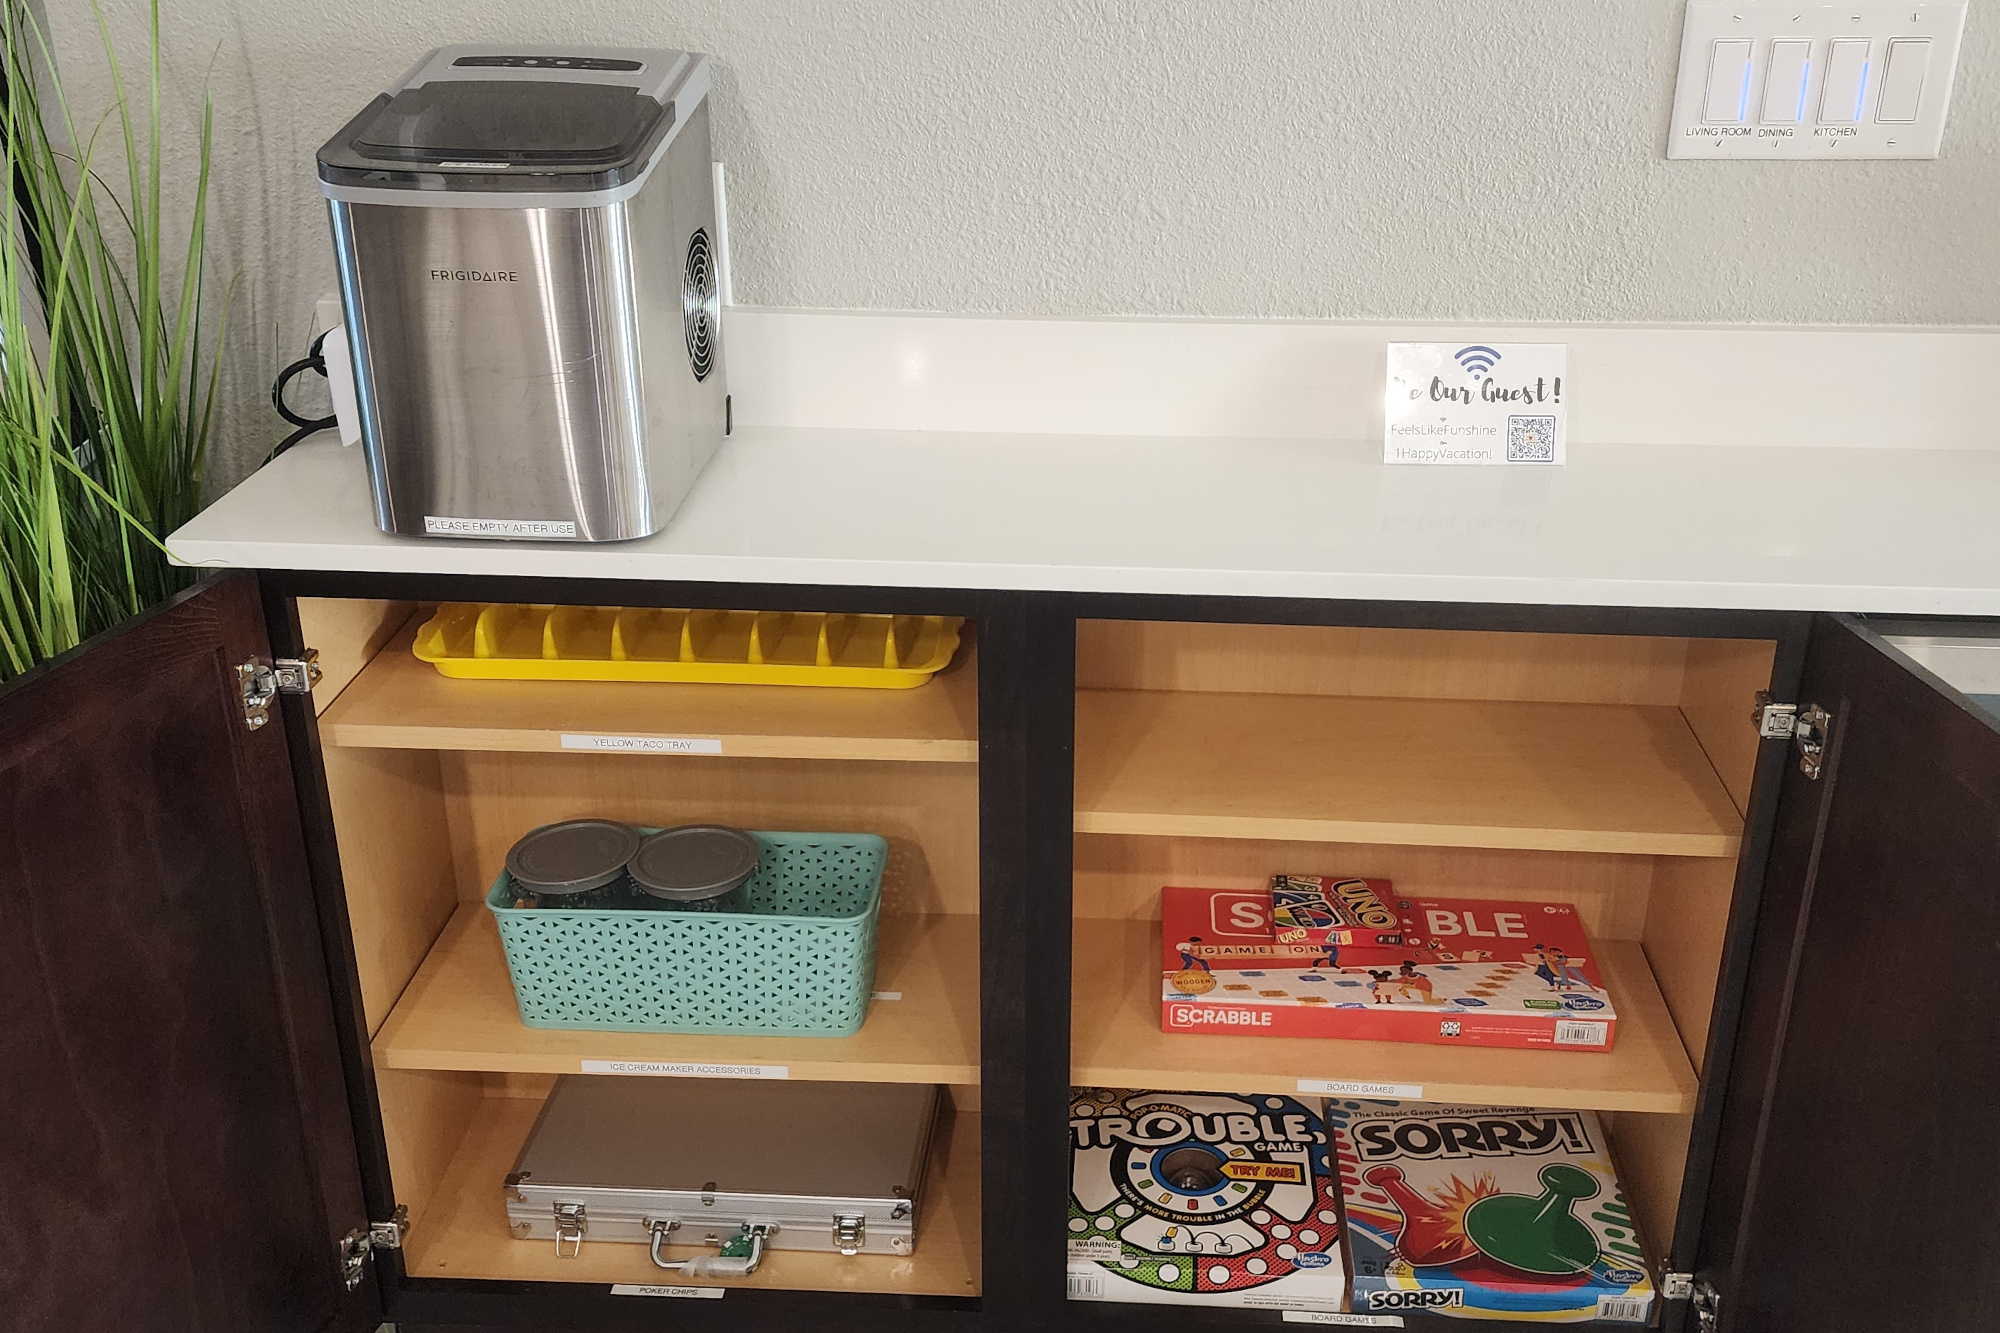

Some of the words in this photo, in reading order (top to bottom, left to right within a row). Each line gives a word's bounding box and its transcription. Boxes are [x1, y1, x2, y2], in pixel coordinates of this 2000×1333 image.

[1685, 127, 1719, 137] LIVING
[1721, 127, 1752, 137] ROOM
[1758, 128, 1794, 138] DINING
[1813, 127, 1858, 137] KITCHEN
[430, 269, 518, 282] FRIGIDAIRE
[1429, 375, 1476, 405] Our
[1390, 424, 1498, 437] FeelsLikeFunshine
[1394, 447, 1493, 462] 1HappyVacation!
[427, 519, 470, 531] PLEASE
[472, 522, 510, 533] EMPTY
[512, 523, 549, 534] AFTER
[551, 524, 575, 534] USE
[593, 738, 635, 748] YELLOW
[636, 739, 664, 749] TACO
[666, 740, 692, 750] TRAY
[1331, 878, 1397, 929] UNO
[1277, 929, 1308, 944] UNO
[1204, 946, 1267, 954] GAME
[1293, 945, 1320, 954] ON
[1174, 978, 1212, 986] WOODEN
[1175, 1008, 1273, 1026] SCRABBLE
[609, 1063, 626, 1071] ICE
[627, 1063, 660, 1073] CREAM
[662, 1064, 694, 1074] MAKER
[696, 1066, 761, 1075] ACCESSORIES
[1326, 1082, 1359, 1093] BOARD
[1361, 1084, 1395, 1095] GAMES
[1352, 1111, 1372, 1119] The
[1373, 1110, 1409, 1118] Classic
[1457, 1107, 1489, 1115] Sweet
[1069, 1111, 1314, 1147] TROUBLE
[1360, 1117, 1582, 1156] SORRY!
[1253, 1142, 1303, 1152] GAME
[1229, 1164, 1261, 1177] TRY
[1264, 1165, 1297, 1179] ME!
[1119, 1182, 1145, 1207] THERE'S
[1143, 1203, 1170, 1219] MORE
[1171, 1213, 1213, 1223] TROUBLE
[1214, 1213, 1226, 1221] IN
[1227, 1206, 1244, 1218] THE
[1242, 1188, 1267, 1211] BUBBLE
[1075, 1240, 1121, 1249] WARNING:
[639, 1287, 670, 1295] POKER
[671, 1288, 699, 1296] CHIPS
[1371, 1290, 1461, 1309] SORRY!
[1311, 1314, 1343, 1322] BOARD
[1345, 1315, 1378, 1325] GAMES
